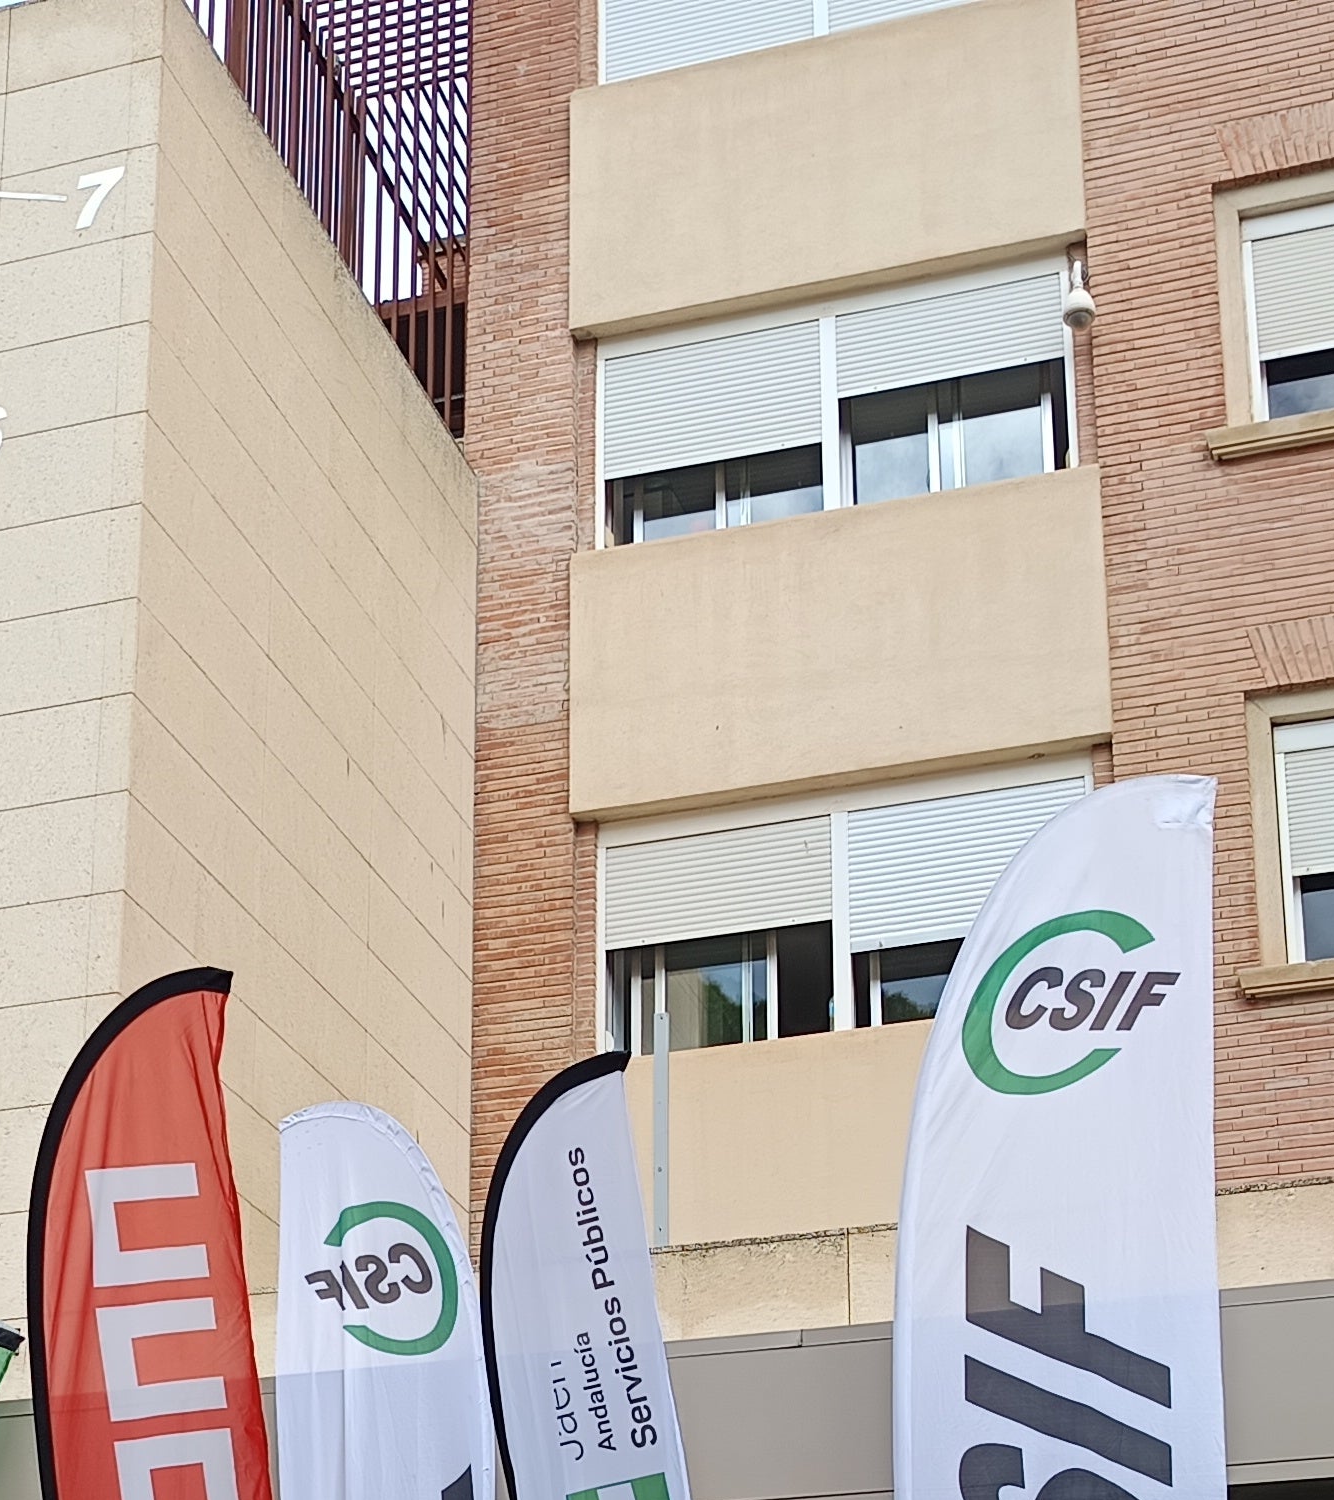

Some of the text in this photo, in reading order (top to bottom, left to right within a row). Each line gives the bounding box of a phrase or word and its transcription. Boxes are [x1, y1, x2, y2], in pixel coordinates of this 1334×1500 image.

[74, 166, 125, 229] 7
[1004, 966, 1181, 1032] CSIF
[568, 1146, 658, 1449] Servicios Públicos
[574, 1330, 616, 1453] Andalucía
